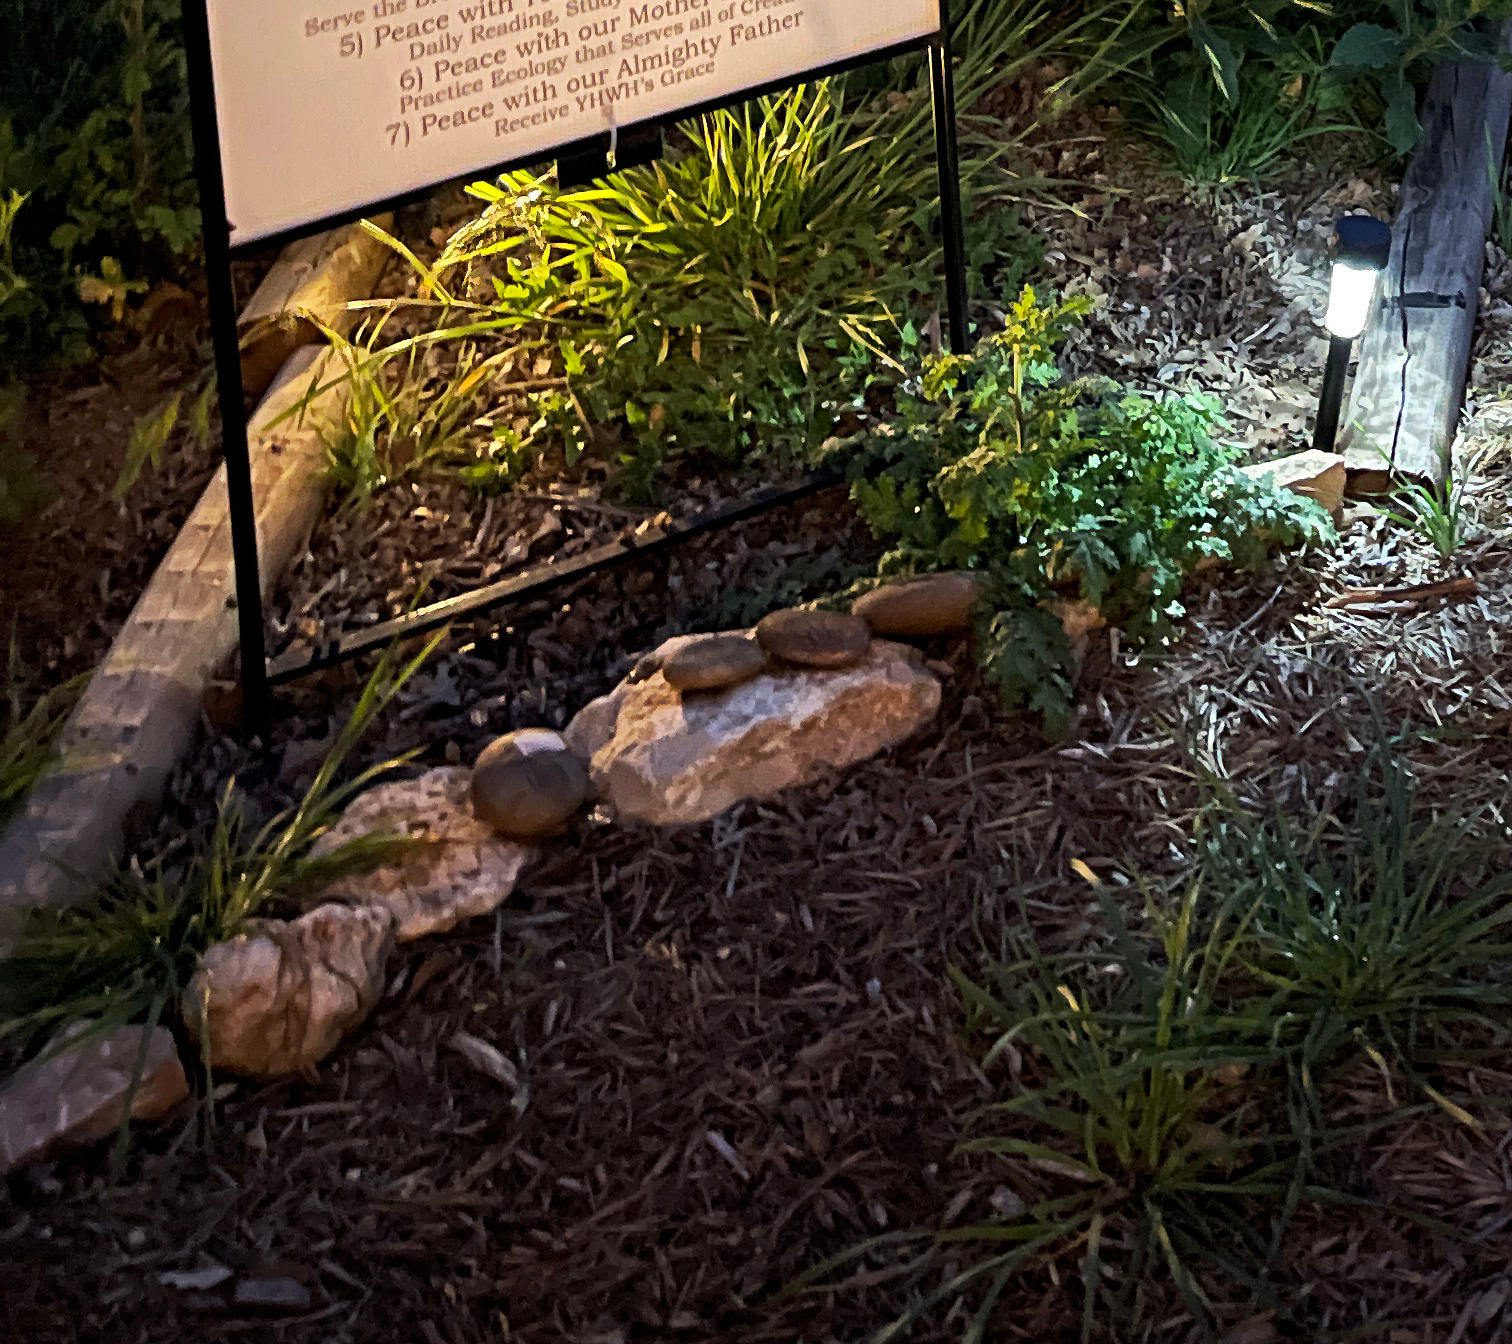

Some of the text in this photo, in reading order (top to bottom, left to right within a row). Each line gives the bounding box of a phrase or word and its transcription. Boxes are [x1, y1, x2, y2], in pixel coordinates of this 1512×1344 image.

[305, 9, 365, 38] Serve
[372, 0, 407, 19] the
[339, 32, 363, 58] 5)
[374, 14, 449, 49] Peace
[399, 67, 423, 93] 6)
[434, 48, 507, 83] Peace
[515, 28, 570, 59] with
[578, 15, 621, 41] our
[400, 79, 484, 115] Practice
[490, 54, 569, 89] Ecology
[575, 40, 616, 64] that
[621, 22, 684, 51] Serves
[689, 9, 712, 32] all
[717, 1, 737, 24] of
[409, 32, 463, 62] Daily
[471, 9, 560, 45] Reading,
[385, 10, 804, 147] 7) Peace with our Almighty Father
[494, 104, 569, 138] Receive
[660, 55, 715, 88] Grace
